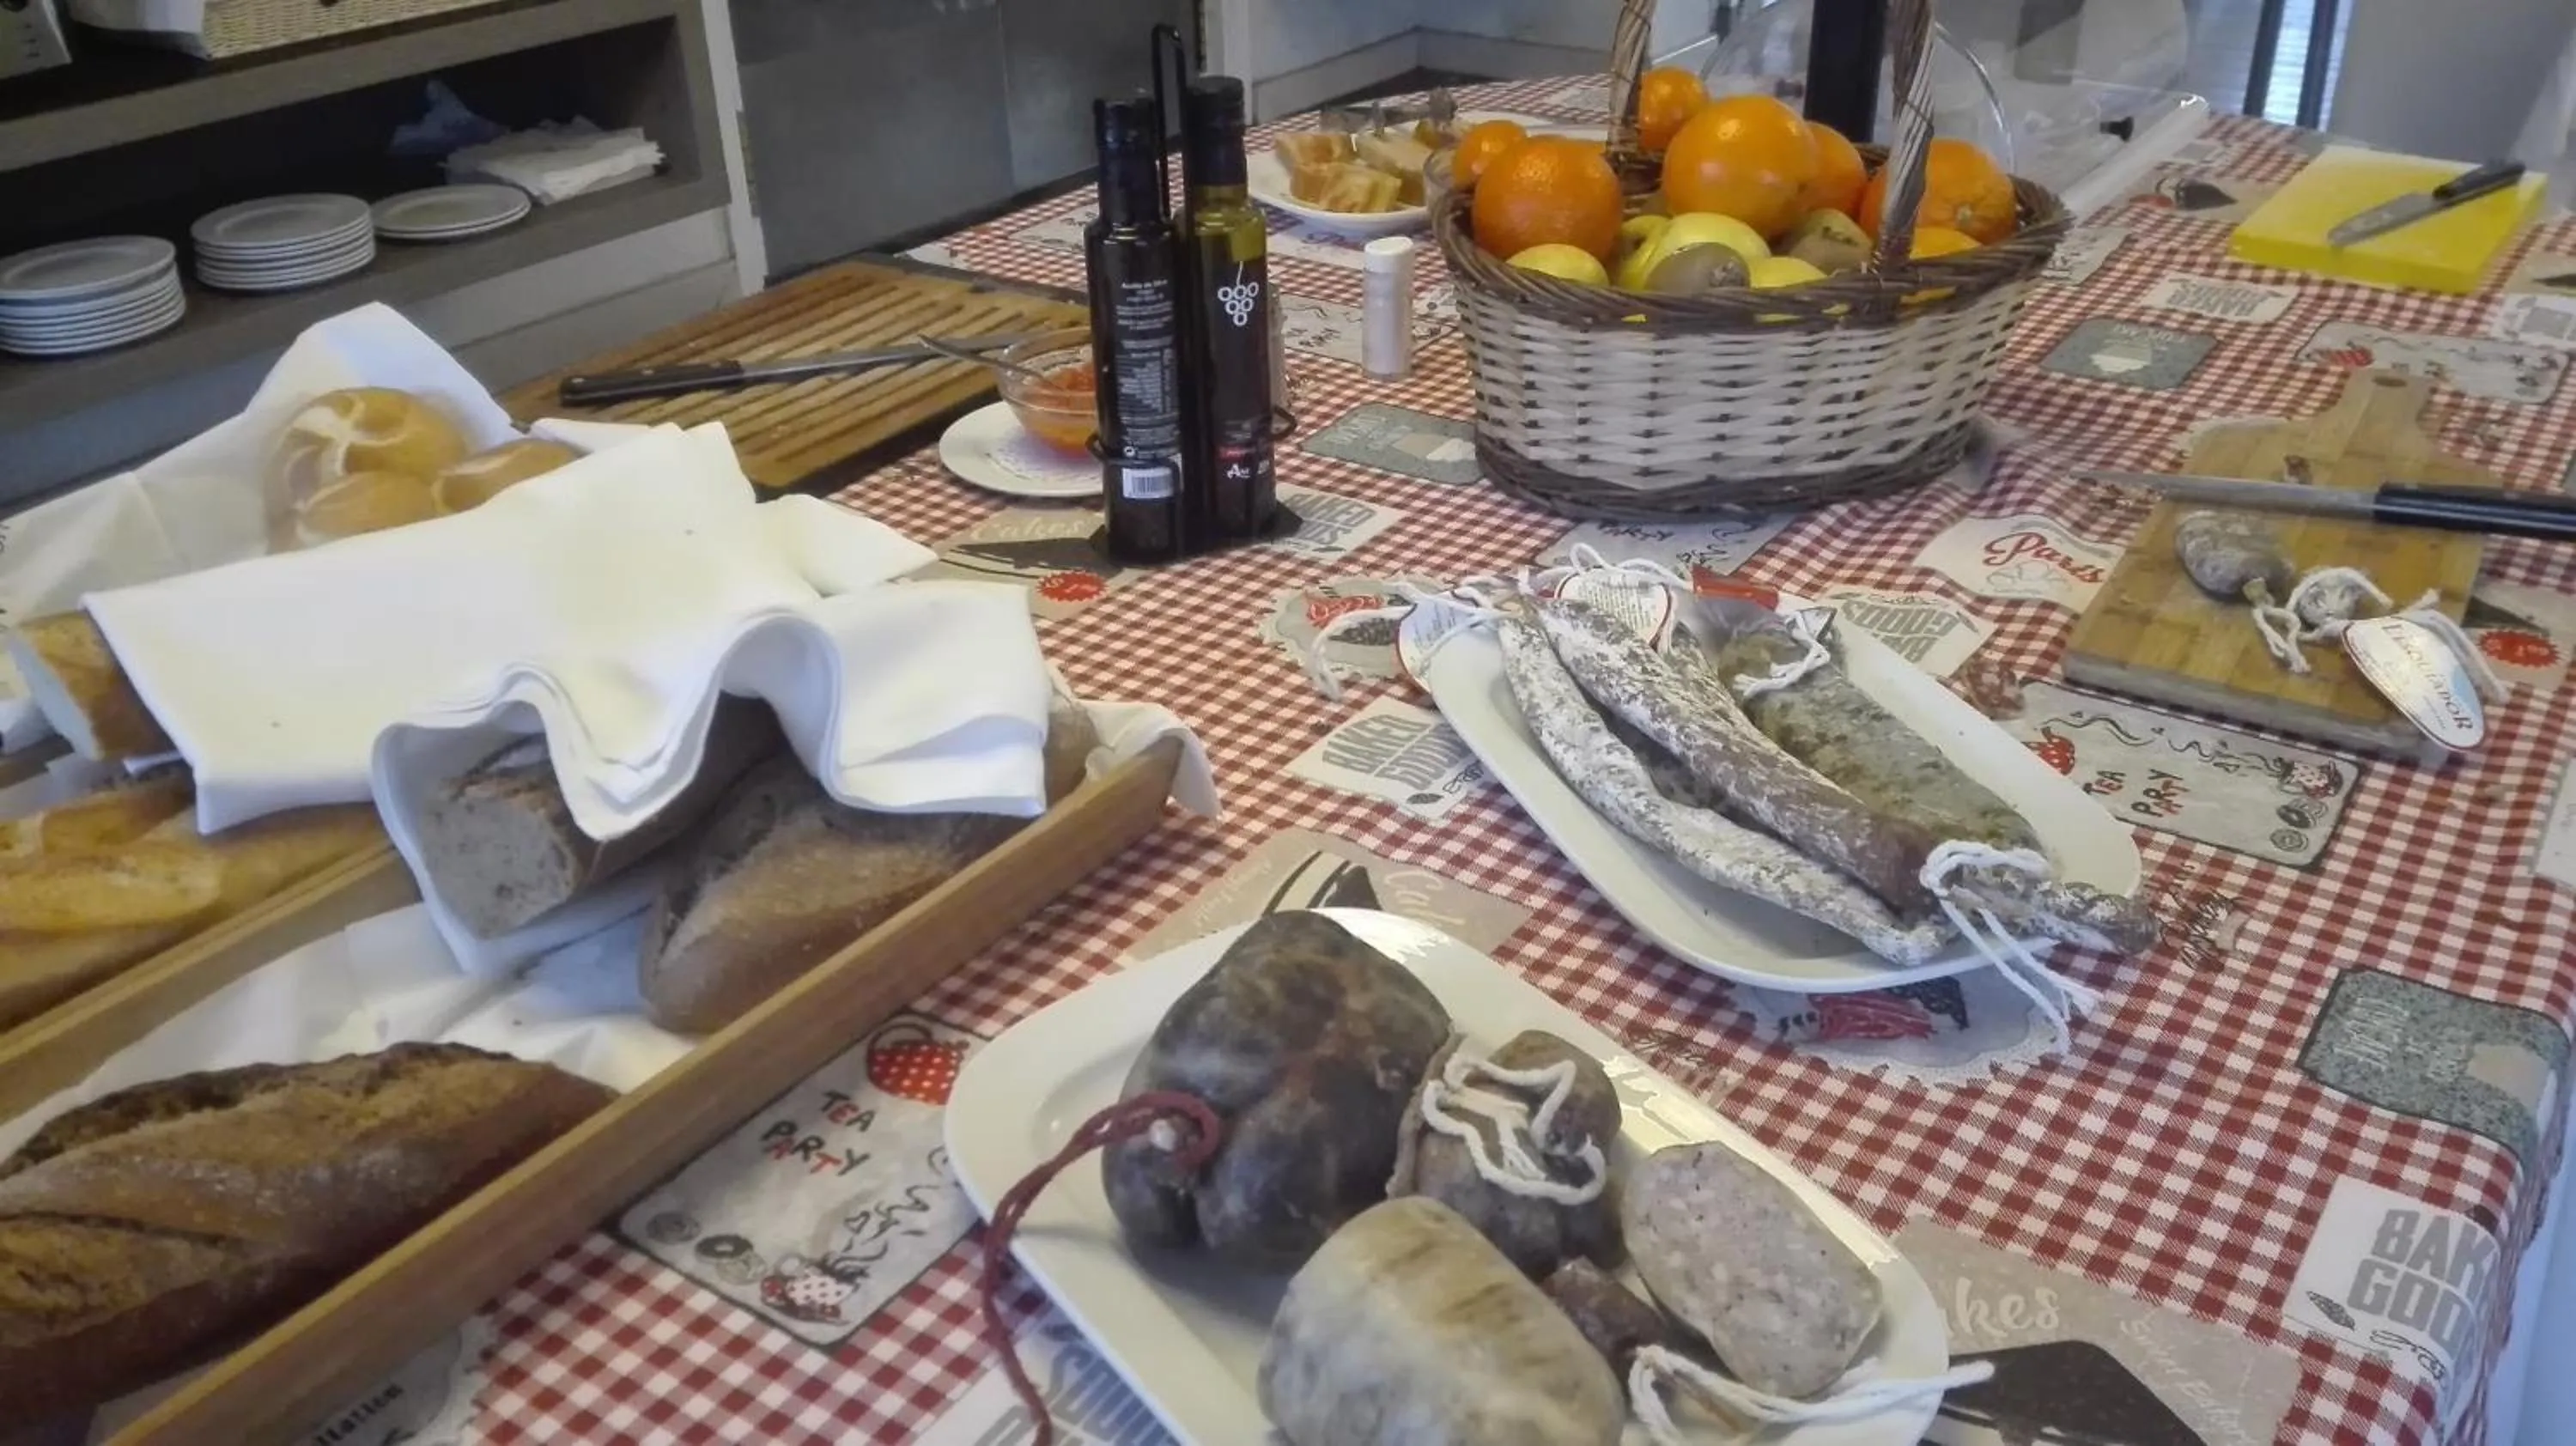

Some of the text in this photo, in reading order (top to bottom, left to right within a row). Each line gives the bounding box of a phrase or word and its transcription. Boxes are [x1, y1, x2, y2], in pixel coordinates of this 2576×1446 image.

[1321, 714, 1433, 775] BAKED
[2081, 769, 2127, 796] TEA
[2129, 768, 2192, 817] PARTY
[818, 1090, 876, 1133] TEA
[761, 1120, 870, 1176] PARTY
[2371, 1208, 2495, 1301] BAK
